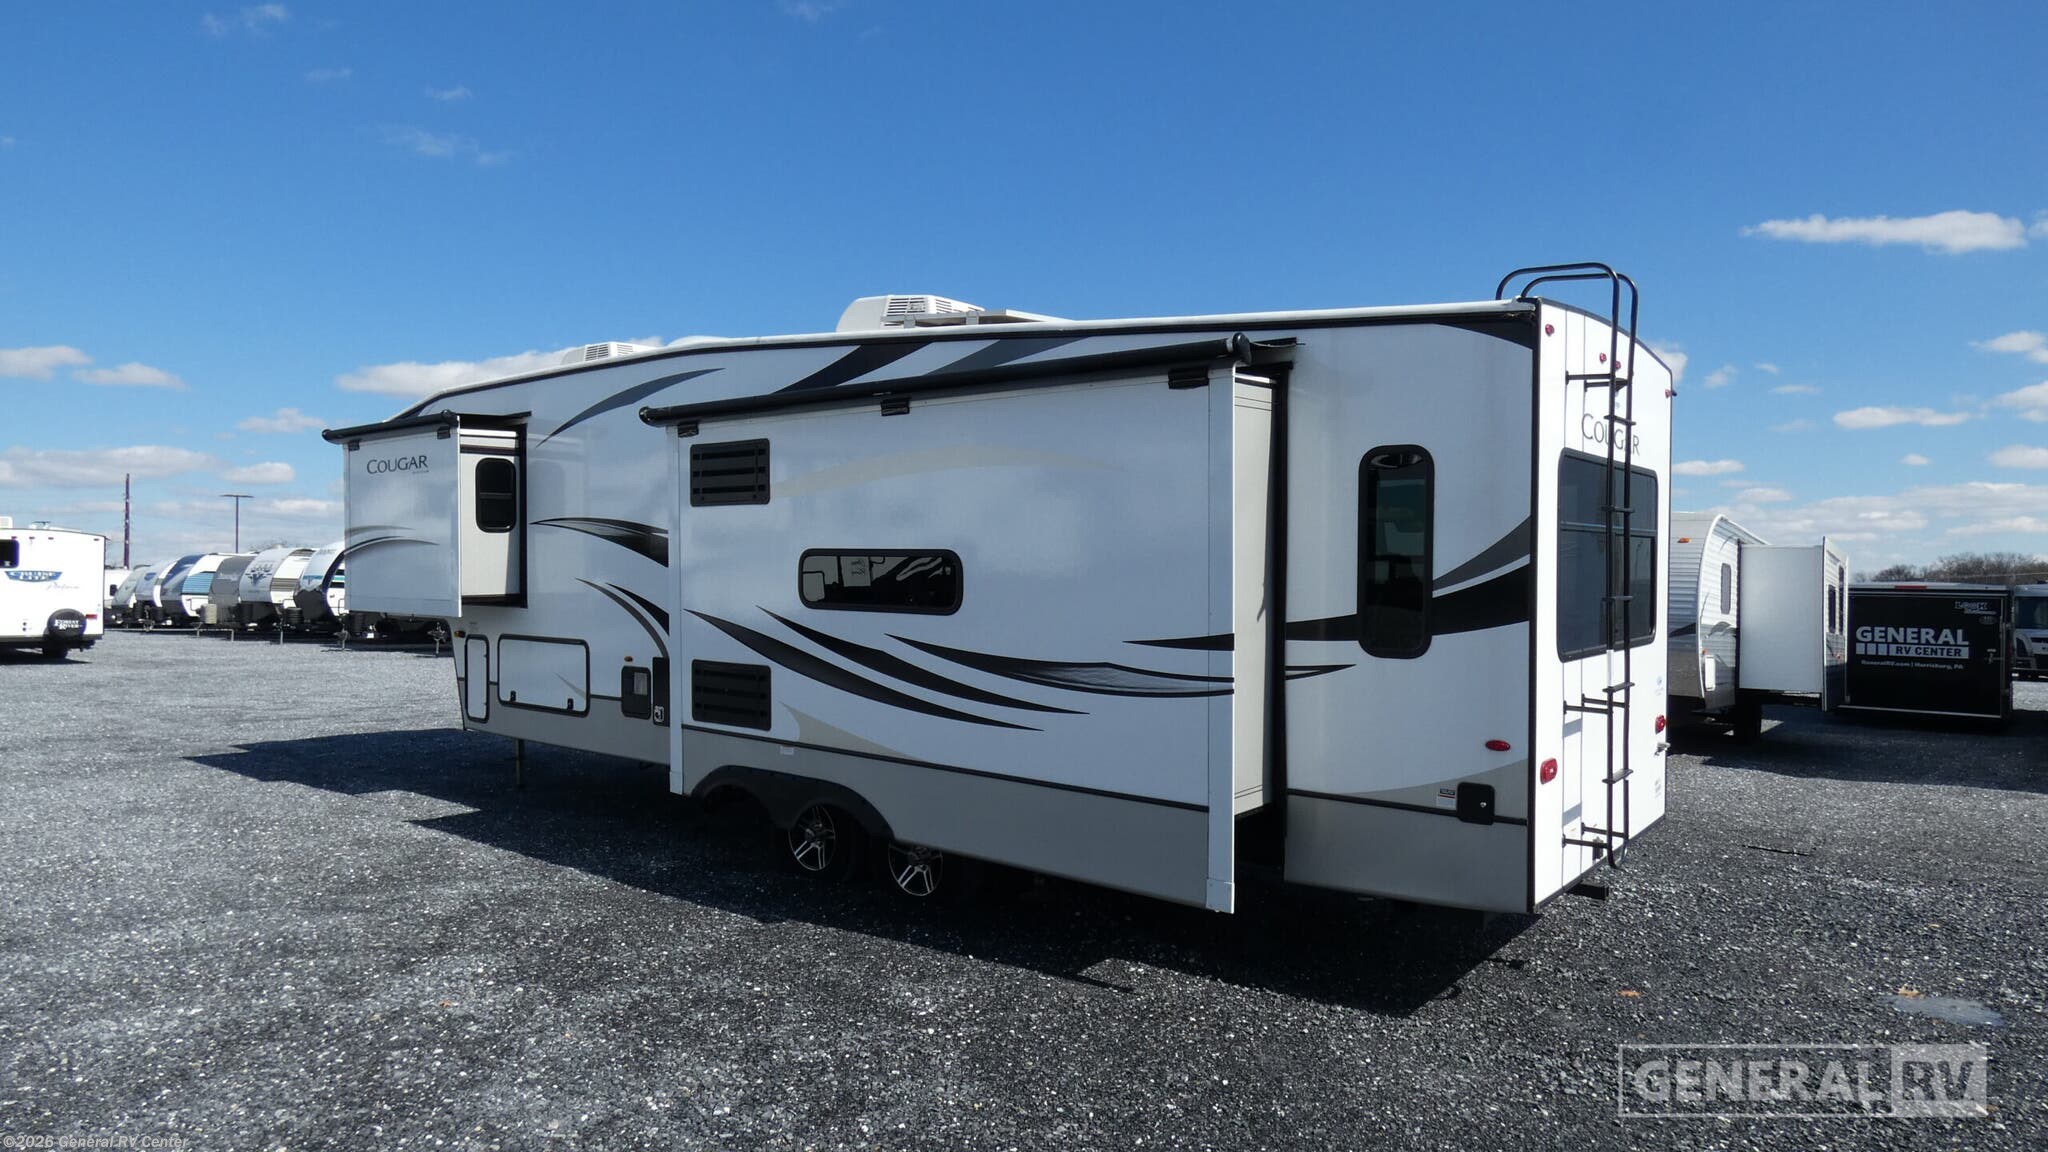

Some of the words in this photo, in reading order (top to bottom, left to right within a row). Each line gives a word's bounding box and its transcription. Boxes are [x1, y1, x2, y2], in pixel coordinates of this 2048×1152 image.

[1581, 413, 1640, 456] COUGR
[366, 455, 429, 475] COUGAR
[1855, 626, 1969, 645] GENERAL
[1896, 645, 1912, 656] RV
[1914, 646, 1962, 657] CENTER
